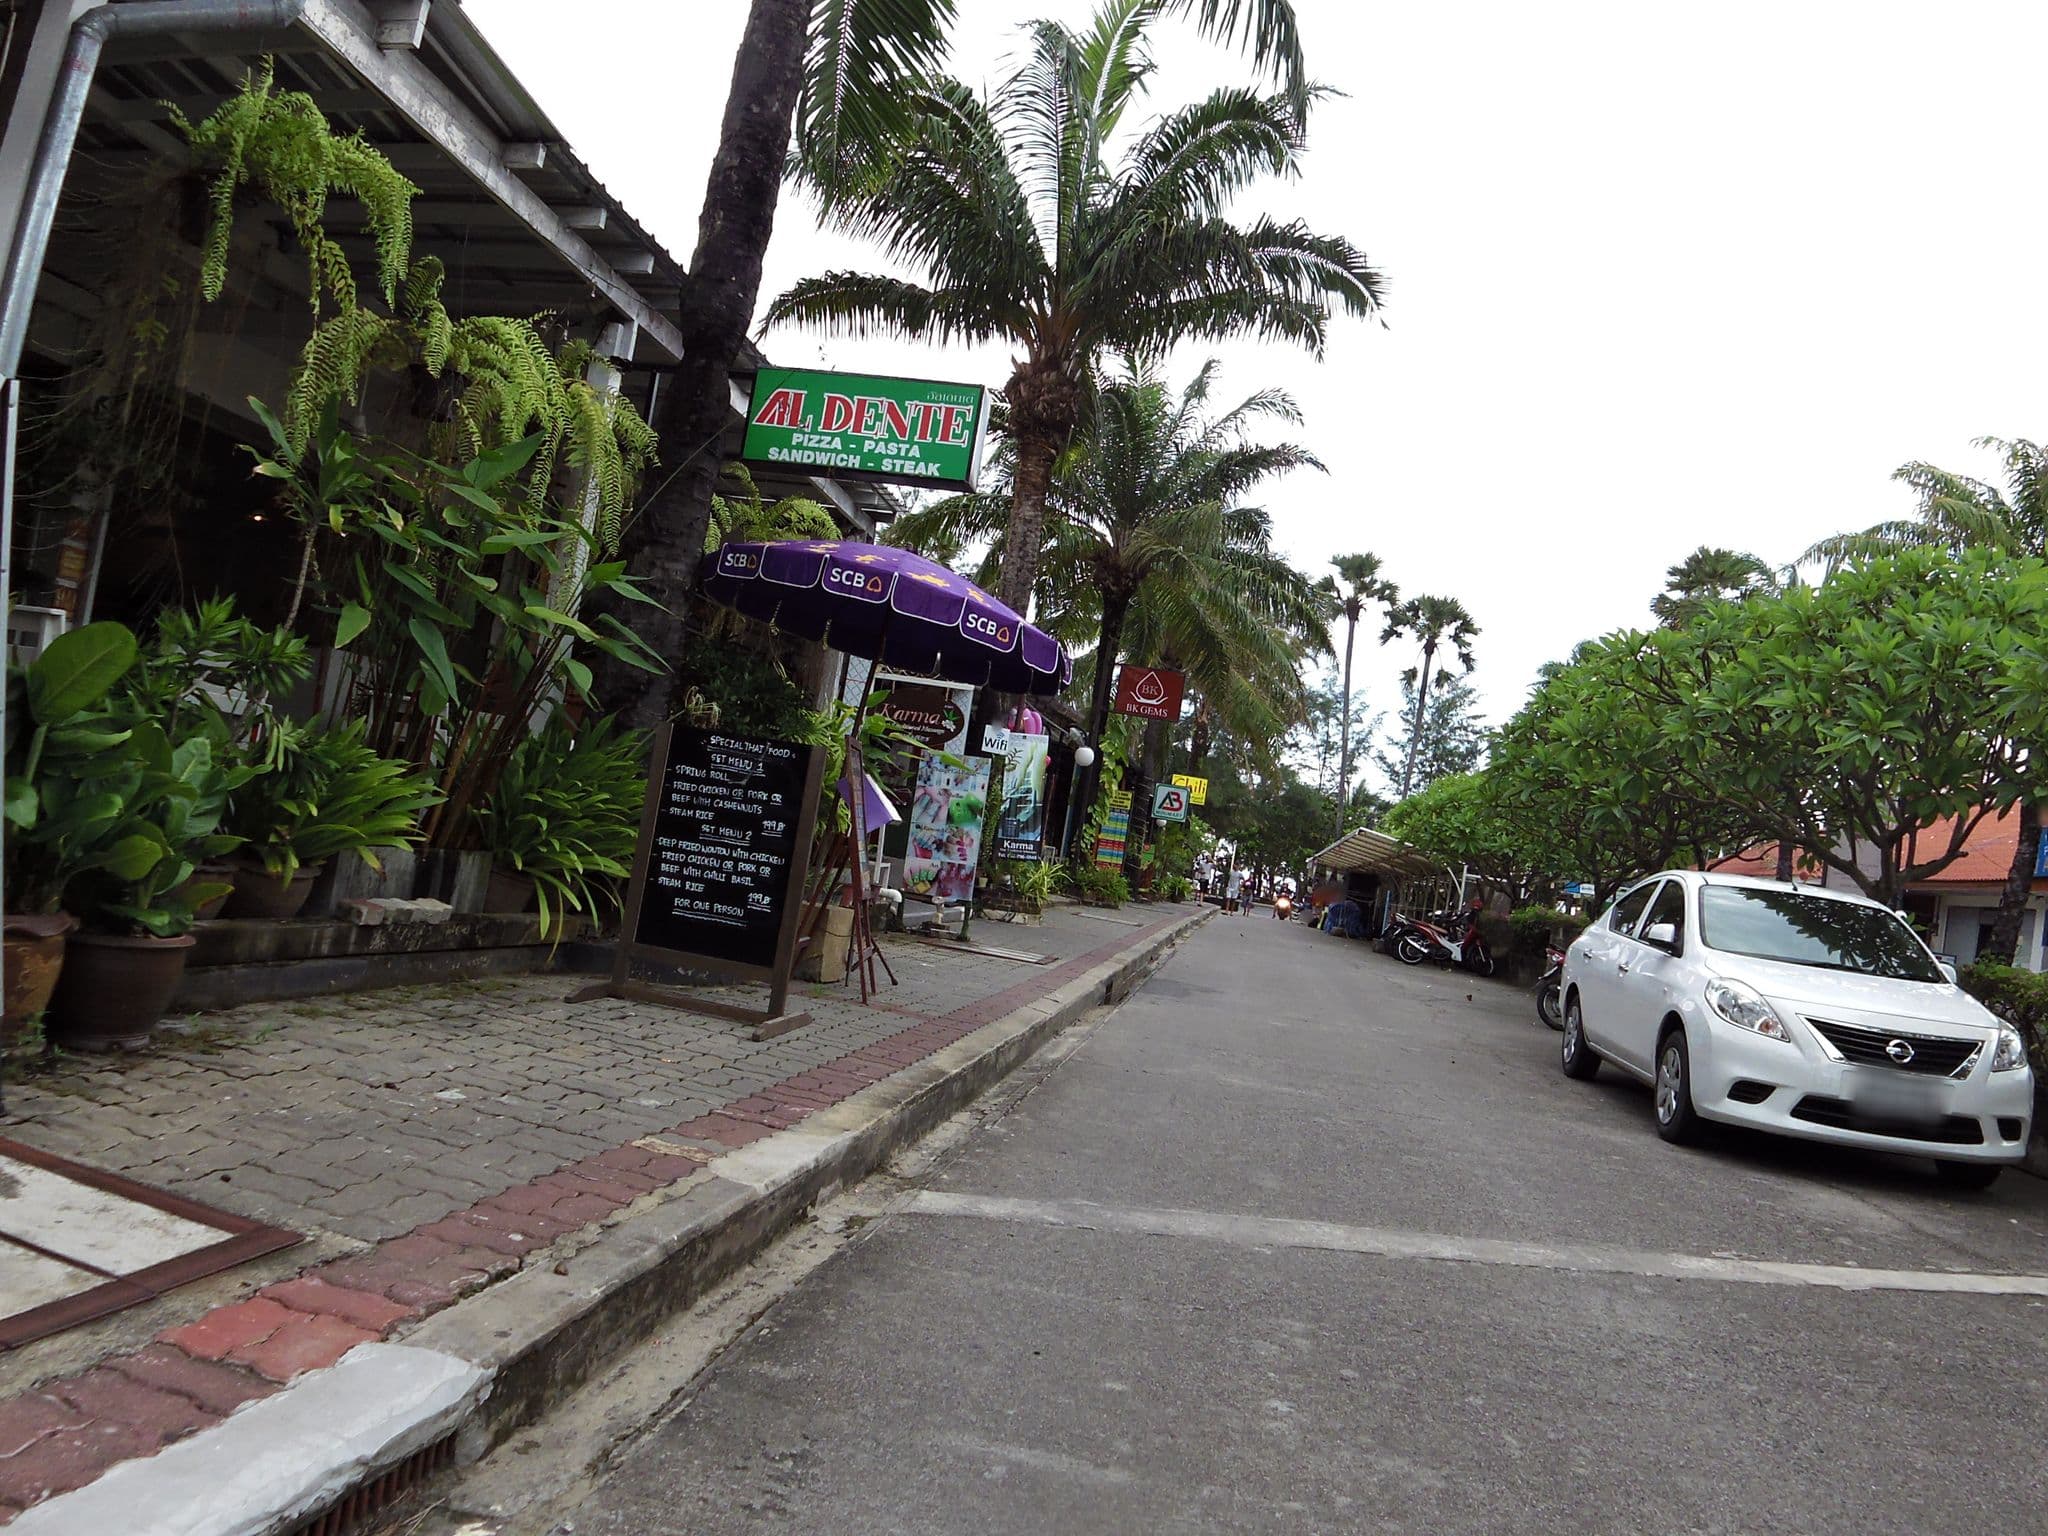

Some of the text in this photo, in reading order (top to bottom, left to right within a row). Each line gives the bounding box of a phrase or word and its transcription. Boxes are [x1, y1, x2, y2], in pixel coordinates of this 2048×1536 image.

[752, 388, 974, 448] AL DENTE
[791, 432, 842, 450] PIZZA
[863, 440, 921, 458] PASTA
[767, 447, 861, 468] SANDWICH
[881, 459, 940, 477] STEAK
[724, 552, 748, 568] SCB
[830, 567, 865, 588] SCB
[966, 613, 997, 636] SCB
[1141, 684, 1159, 696] BK
[880, 703, 941, 725] Karma
[1125, 703, 1169, 718] BK GEMS
[710, 735, 744, 750] SPECIAL
[768, 747, 791, 758] FOOD
[984, 735, 1008, 751] Wifi
[711, 753, 764, 771] SET MENU 1
[675, 765, 730, 781] SPRING ROLL
[671, 793, 690, 803] BEEF
[673, 781, 782, 803] FRIED CHICKEN OR PORK OR
[669, 807, 715, 820] STEAM RICE
[701, 824, 752, 840] SET MENU 2
[678, 840, 701, 851] FRIED
[750, 852, 785, 865] CHICKEN
[1003, 840, 1034, 850] Karma
[662, 851, 771, 875] FRIED CHICKEN OR PORK OR
[658, 876, 705, 892] STEAM RICE
[660, 863, 680, 873] BEEF
[731, 874, 755, 886] BASIL
[674, 897, 744, 917] FOR ONE PERSON
